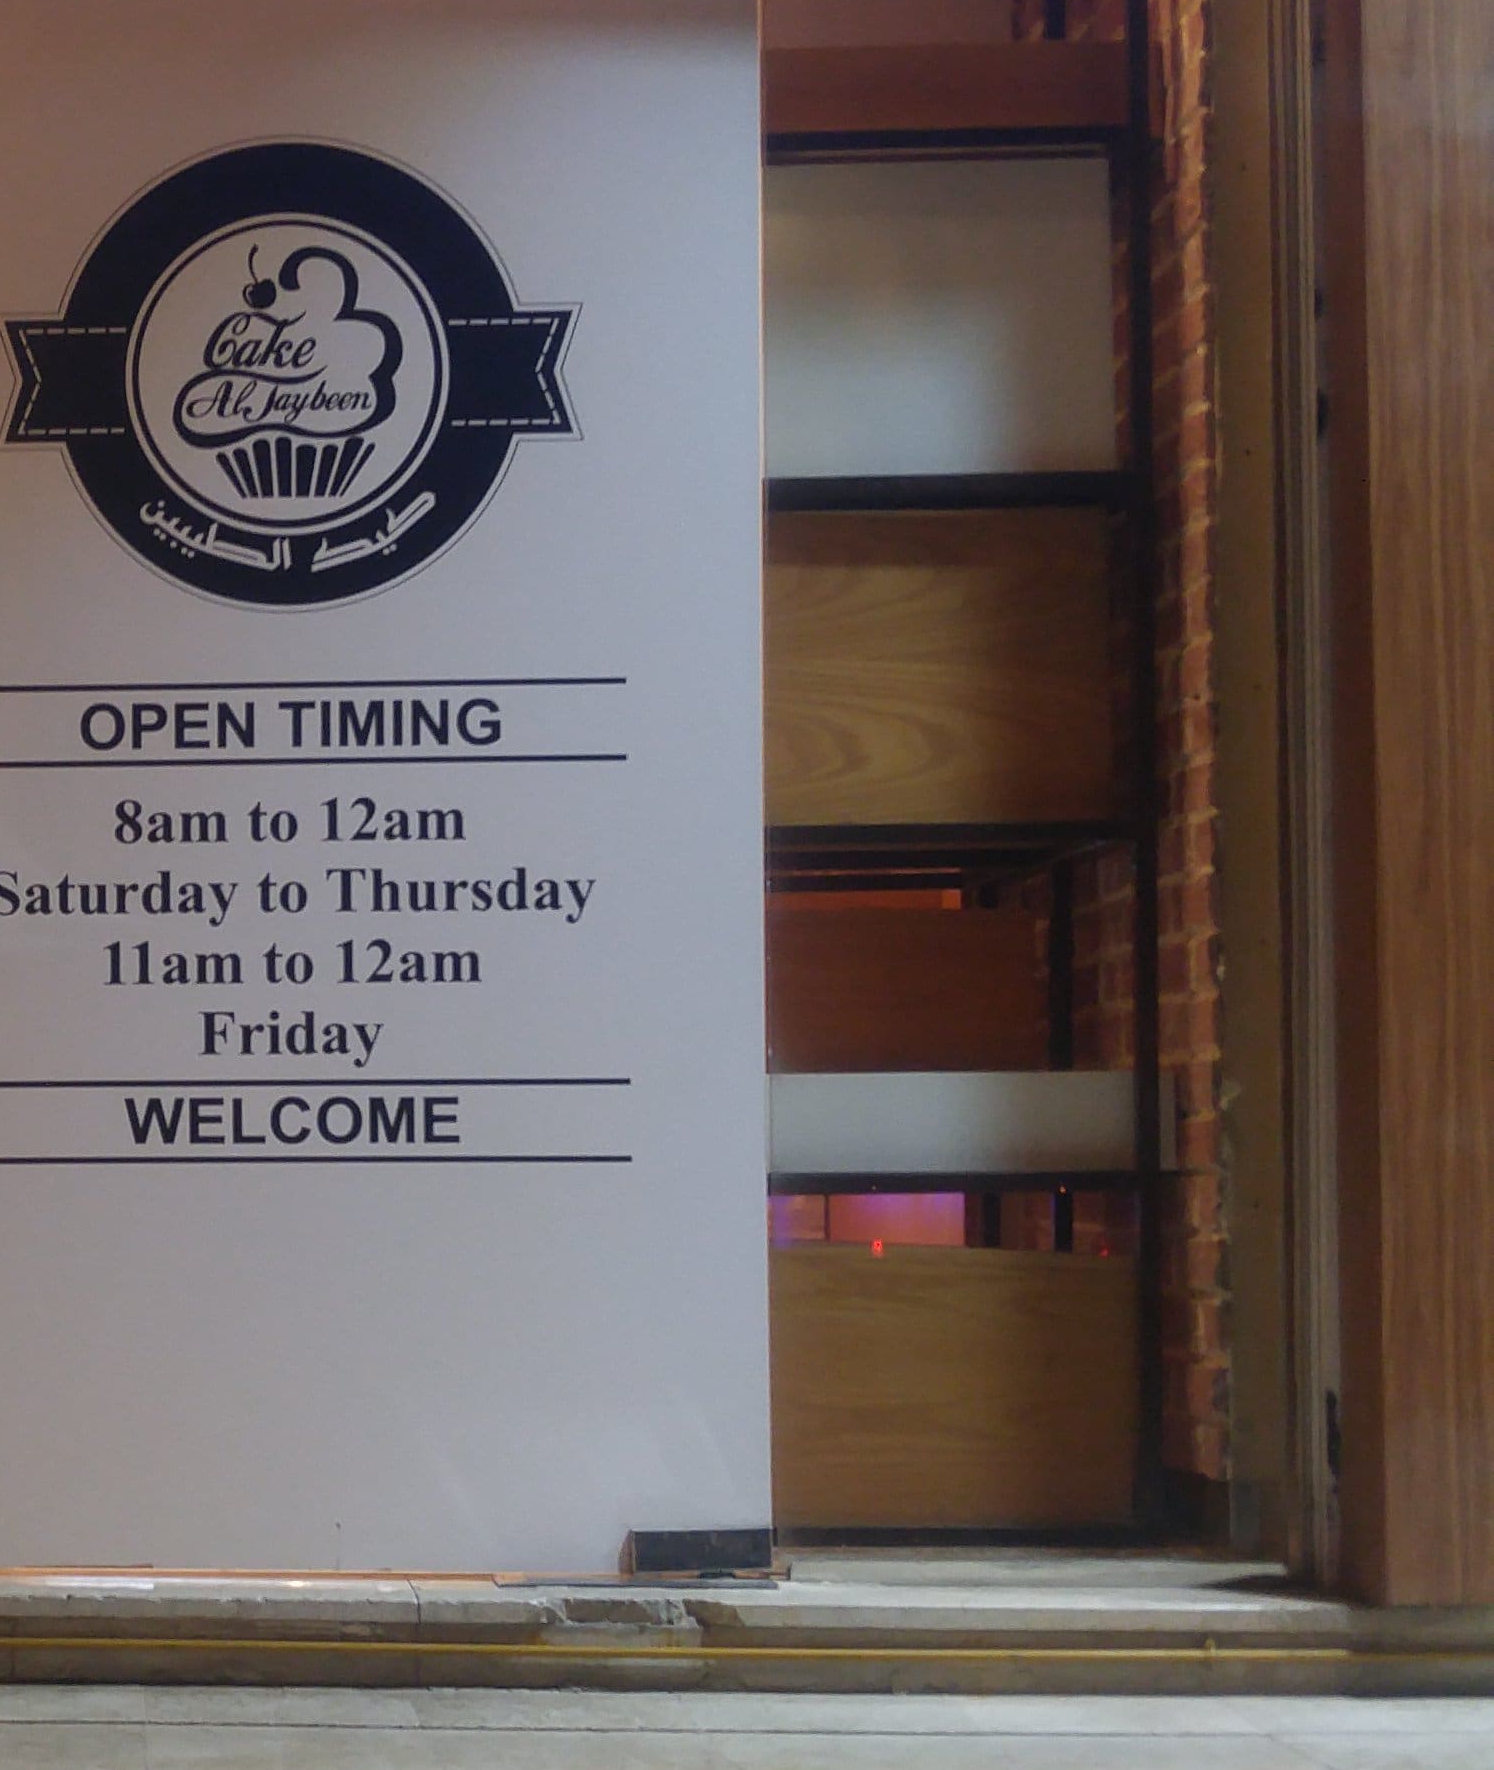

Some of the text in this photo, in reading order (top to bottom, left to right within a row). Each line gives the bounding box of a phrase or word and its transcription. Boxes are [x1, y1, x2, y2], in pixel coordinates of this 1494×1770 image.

[203, 307, 317, 370] Cake
[139, 499, 293, 572] الطيبين
[81, 699, 502, 750] OPEN TIMING
[114, 797, 465, 845] 8am to 12am
[258, 872, 308, 914] to
[326, 867, 596, 923] Thursday
[103, 939, 482, 986] 11am to 12am
[199, 1010, 384, 1068] Friday
[124, 1096, 460, 1145] WELCOME
